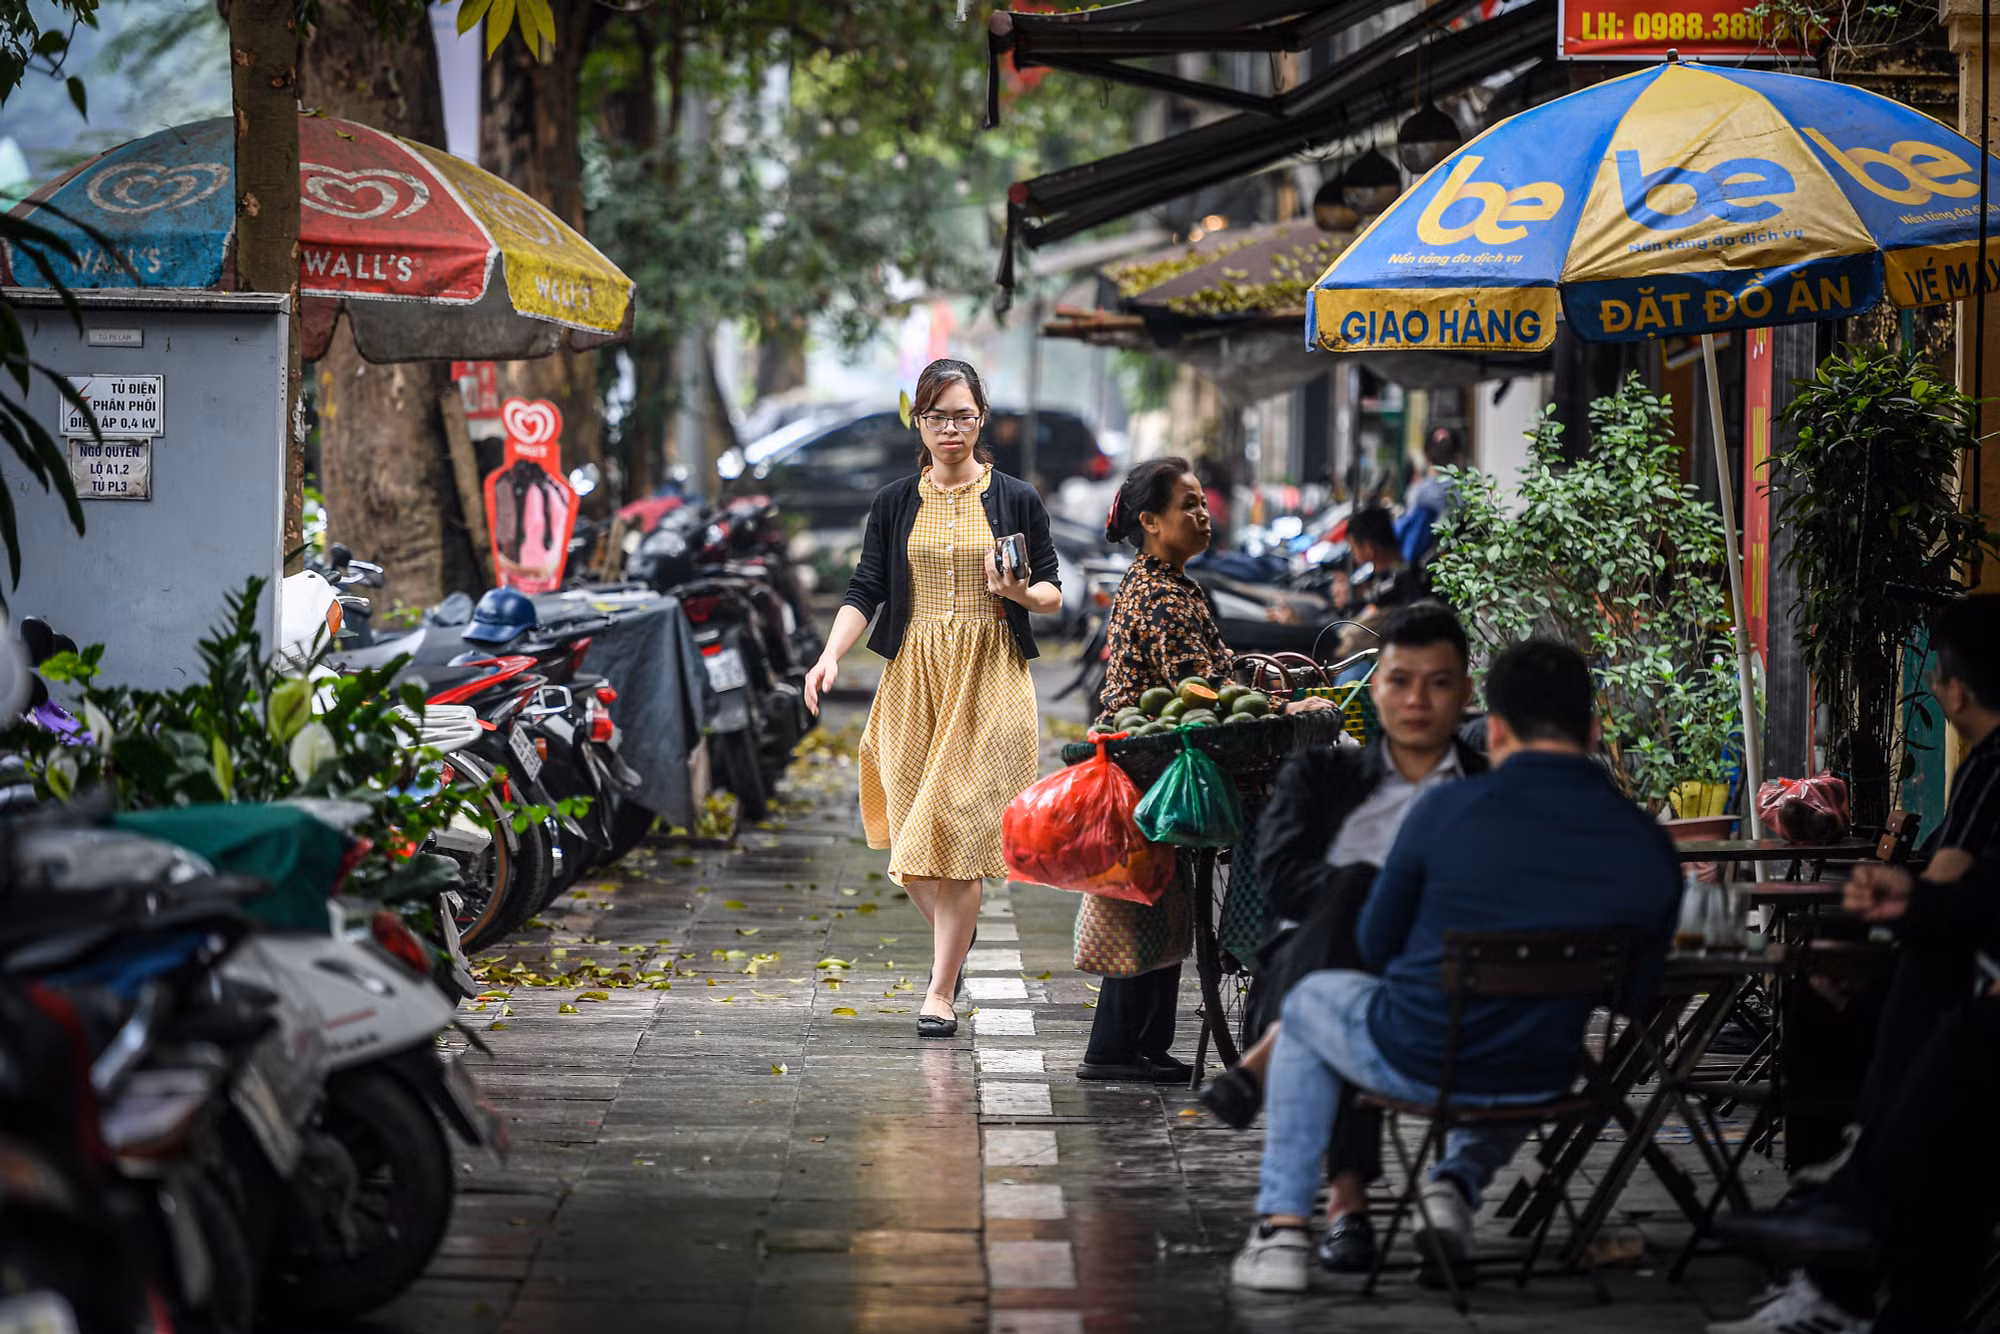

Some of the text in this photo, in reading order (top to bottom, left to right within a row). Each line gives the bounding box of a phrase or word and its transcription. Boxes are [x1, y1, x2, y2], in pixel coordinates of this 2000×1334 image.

[1581, 12, 1624, 40] LH:
[1800, 127, 1980, 205] be
[1416, 155, 1565, 246] be
[1615, 149, 1796, 231] be
[1666, 236, 1709, 250] tảng
[1712, 234, 1736, 246] đa
[1740, 230, 1778, 246] dịch
[1783, 229, 1804, 240] vụ
[303, 249, 413, 282] WALL'S
[1418, 252, 1451, 266] tảng
[1451, 252, 1472, 264] đa
[1472, 252, 1504, 266] dịch
[1506, 254, 1523, 265] vụ
[1904, 257, 1942, 304] VÉ
[1599, 270, 1852, 338] ĐẶT ĐỒ ĂN
[1340, 299, 1541, 344] GIAO HÀNG
[111, 379, 156, 397] TỦ ĐIỆN
[93, 397, 156, 411] PHÂN PHỐI
[101, 415, 117, 428] ÁP
[120, 417, 138, 430] 0,4
[142, 417, 156, 429] kV
[90, 461, 129, 477] LỘ A1.2
[92, 476, 127, 492] TỦ PL3
